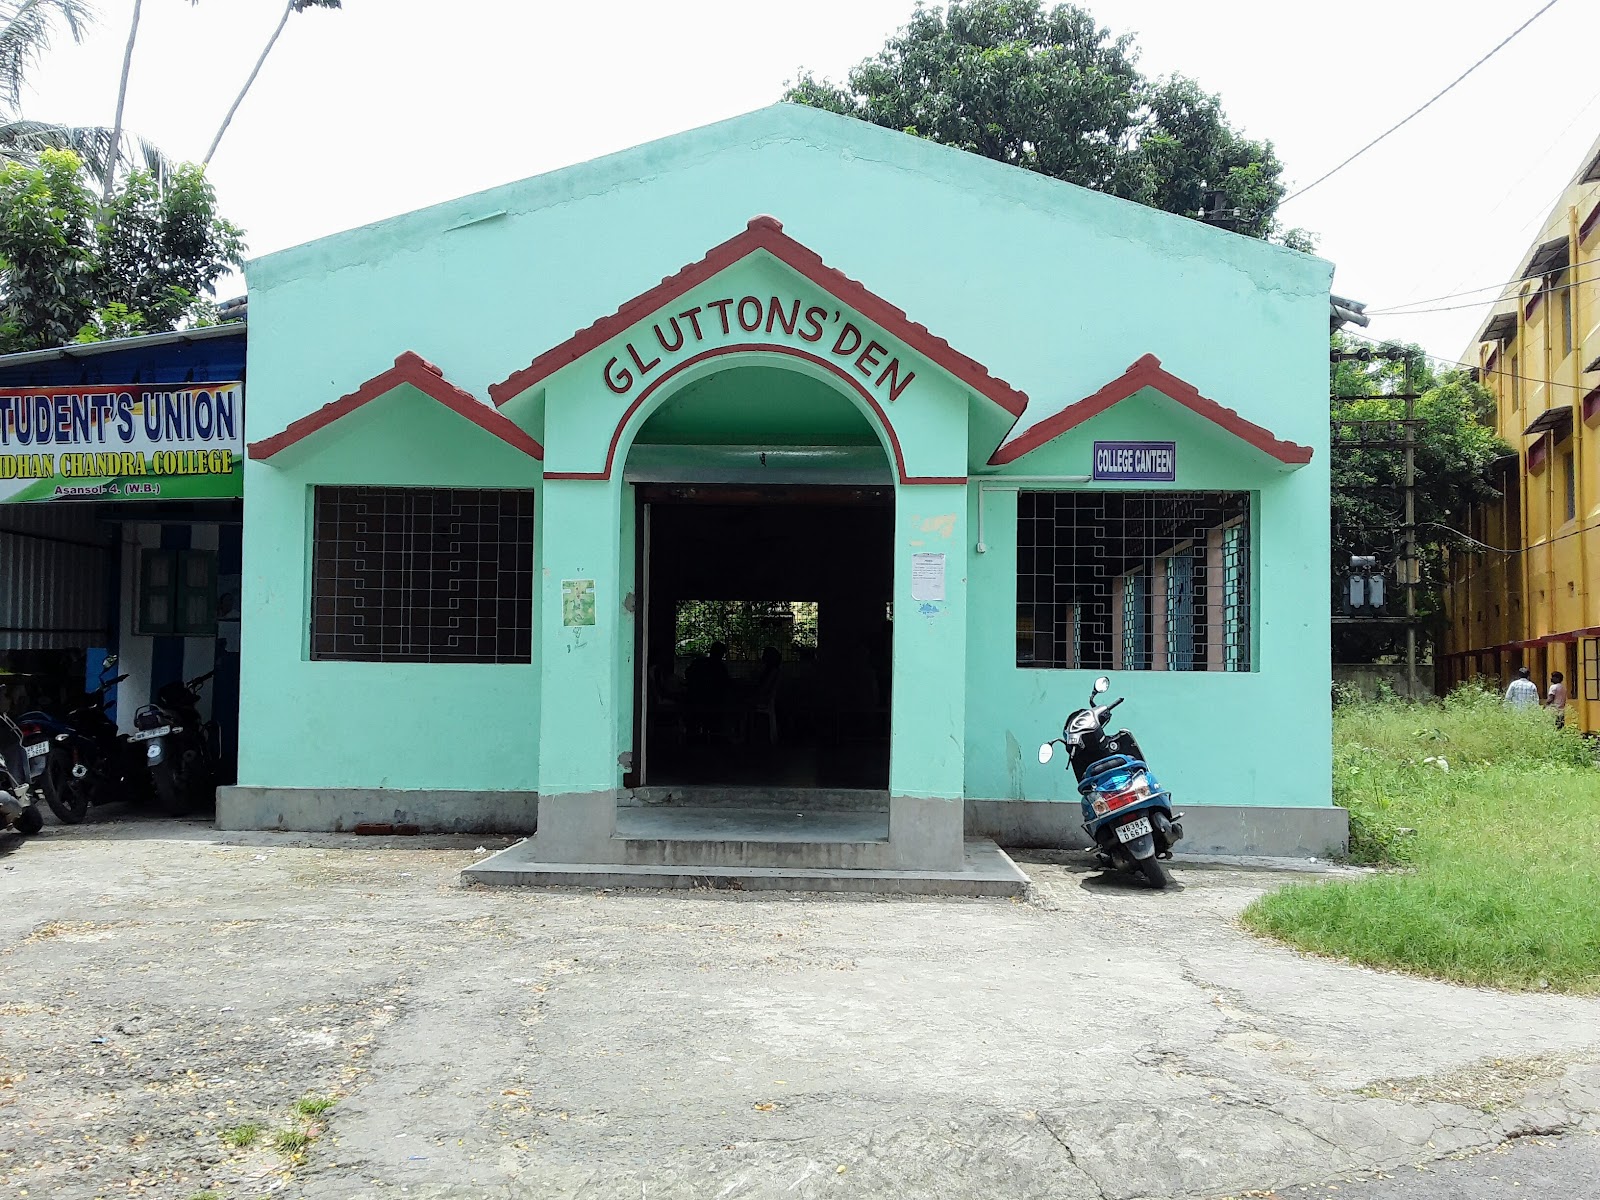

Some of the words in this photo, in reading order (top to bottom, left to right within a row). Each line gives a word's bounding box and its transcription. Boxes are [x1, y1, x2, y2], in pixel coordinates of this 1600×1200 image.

[143, 391, 236, 442] UNION
[59, 451, 147, 478] CHANDRA
[151, 449, 233, 475] COLLEGE
[1097, 449, 1133, 473] COLLEGE
[1134, 449, 1172, 473] CANTEEN
